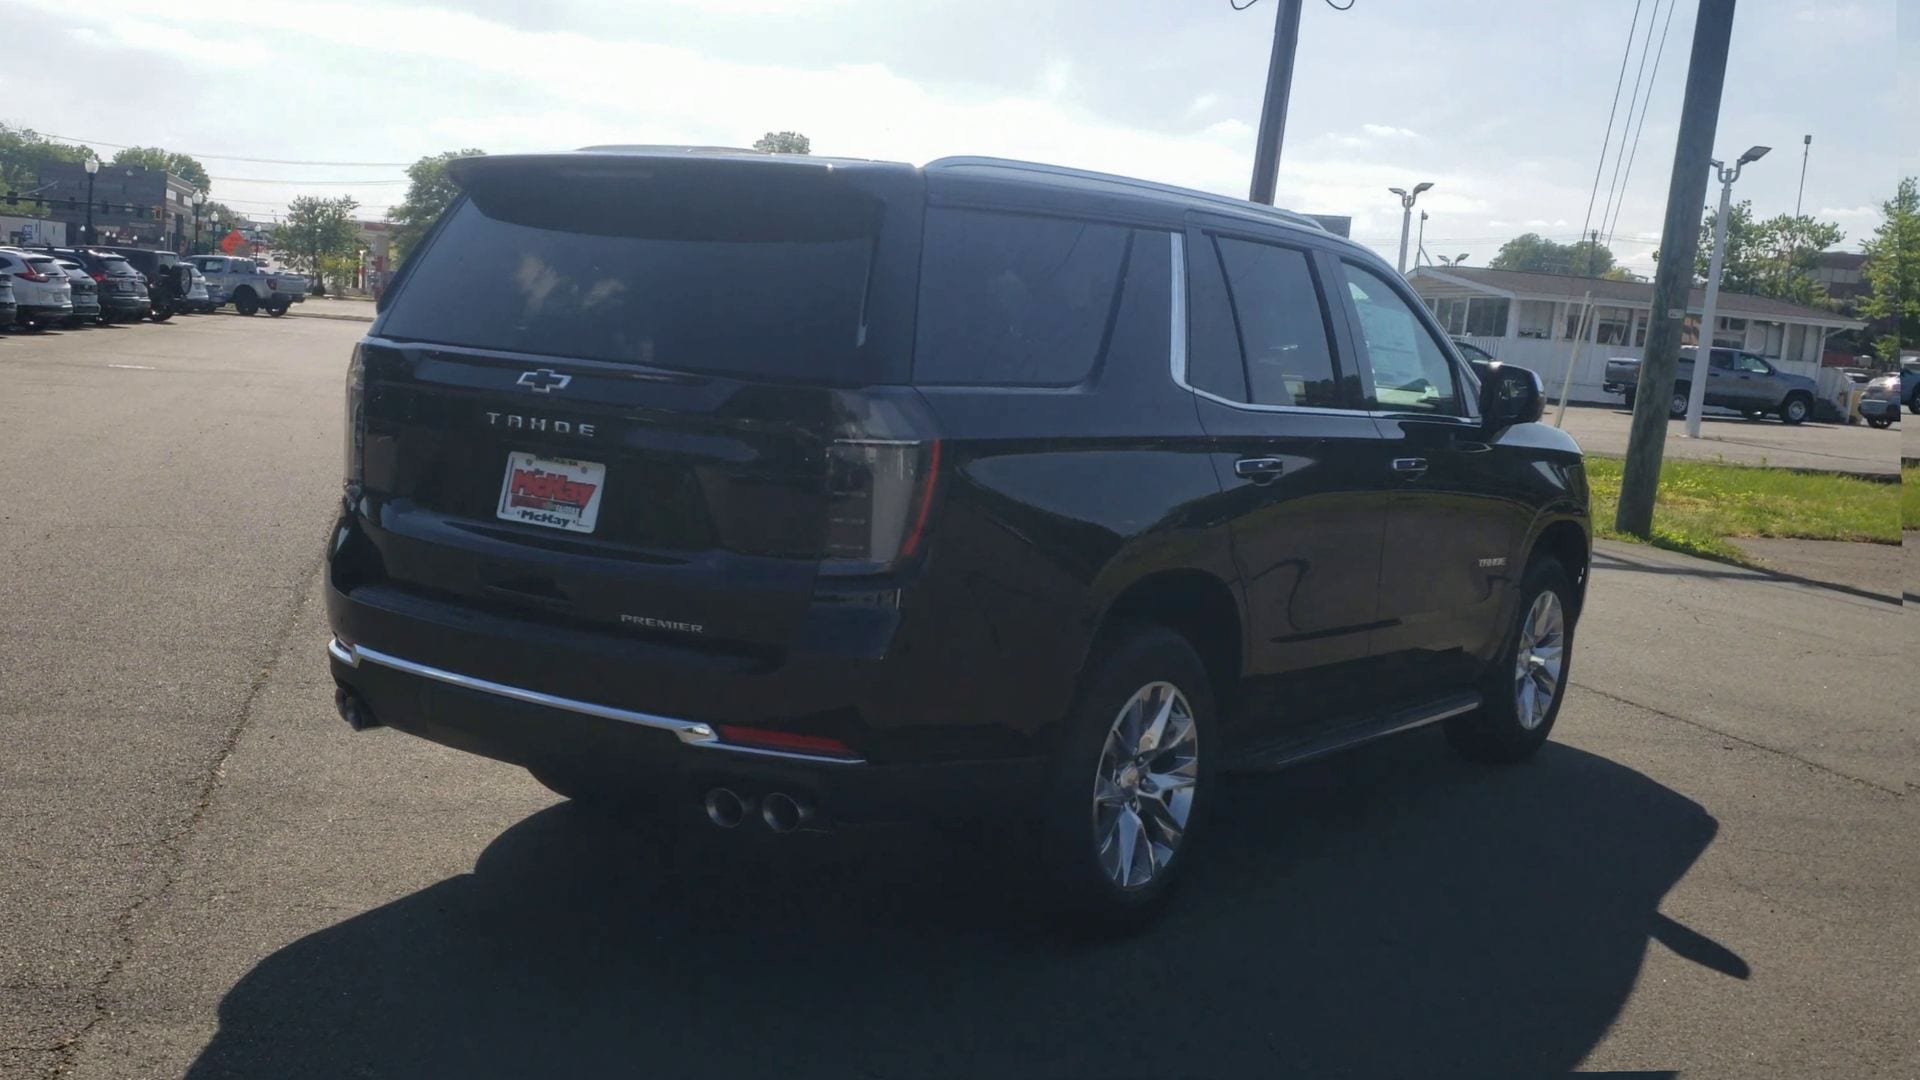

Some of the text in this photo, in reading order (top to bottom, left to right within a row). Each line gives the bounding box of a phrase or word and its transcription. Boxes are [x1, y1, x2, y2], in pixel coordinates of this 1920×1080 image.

[486, 411, 595, 437] TAHOE
[520, 510, 570, 527] McKay
[620, 614, 703, 634] PREMIER
